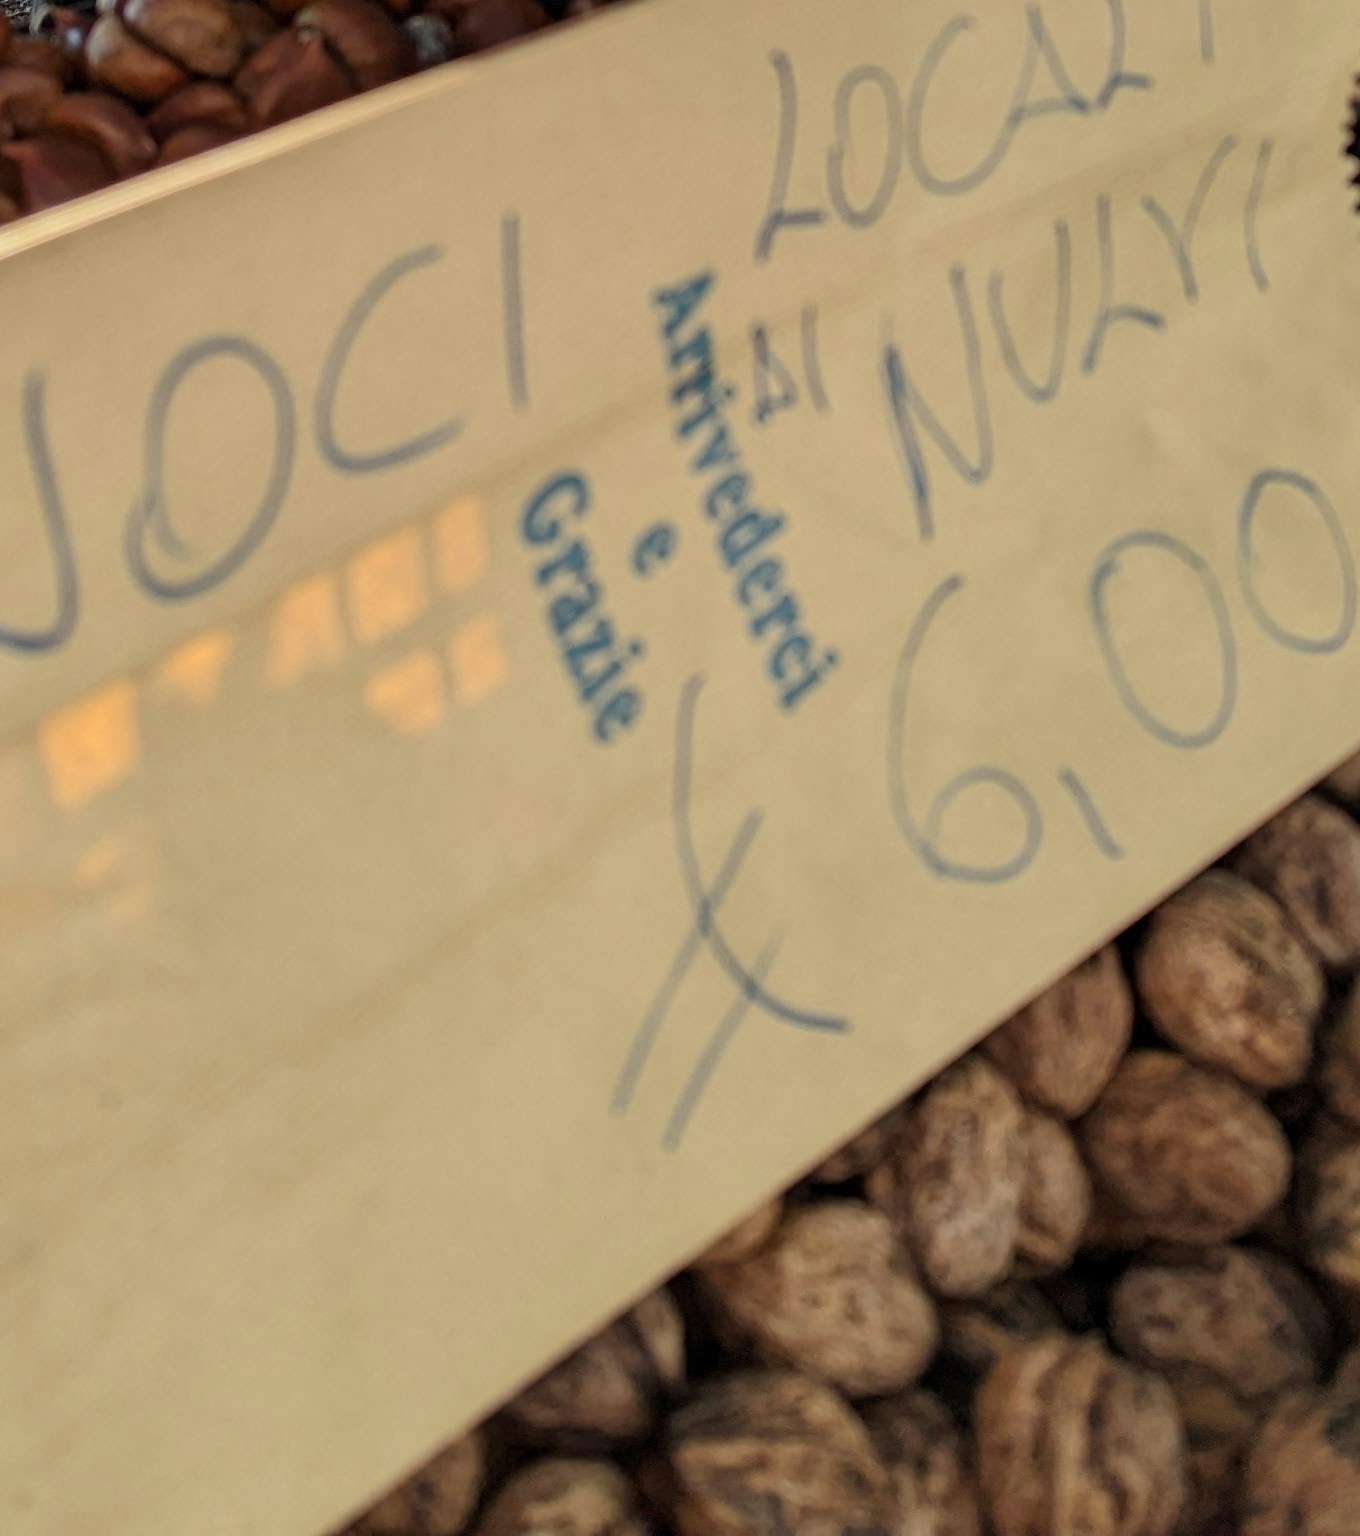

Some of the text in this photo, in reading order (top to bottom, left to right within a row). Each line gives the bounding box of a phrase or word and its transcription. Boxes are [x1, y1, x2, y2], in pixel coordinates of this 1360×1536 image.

[520, 469, 648, 746] Grazie
[630, 520, 677, 579] e
[653, 269, 840, 712] Arrivederci
[885, 469, 1359, 883] 6,00
